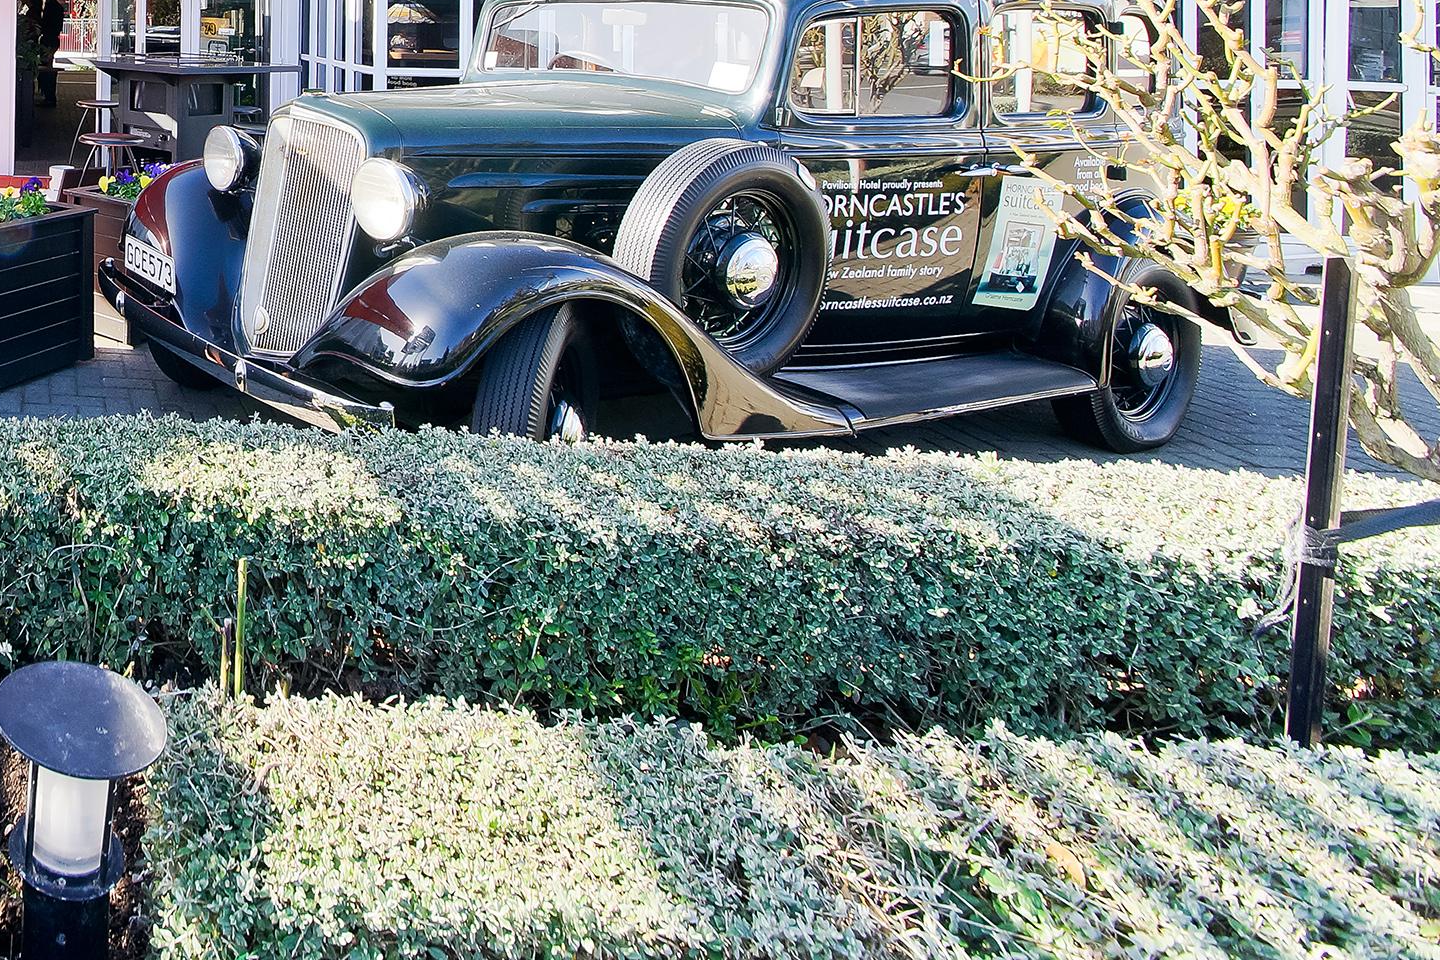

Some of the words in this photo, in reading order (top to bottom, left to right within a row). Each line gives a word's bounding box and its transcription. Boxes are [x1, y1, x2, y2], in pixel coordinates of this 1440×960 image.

[1077, 168, 1092, 179] from
[860, 181, 880, 190] Hotel
[882, 179, 911, 191] proudly
[913, 179, 943, 190] presents
[127, 243, 173, 287] GCE573
[841, 265, 885, 279] Zealand
[887, 264, 917, 279] family
[919, 265, 944, 278] story
